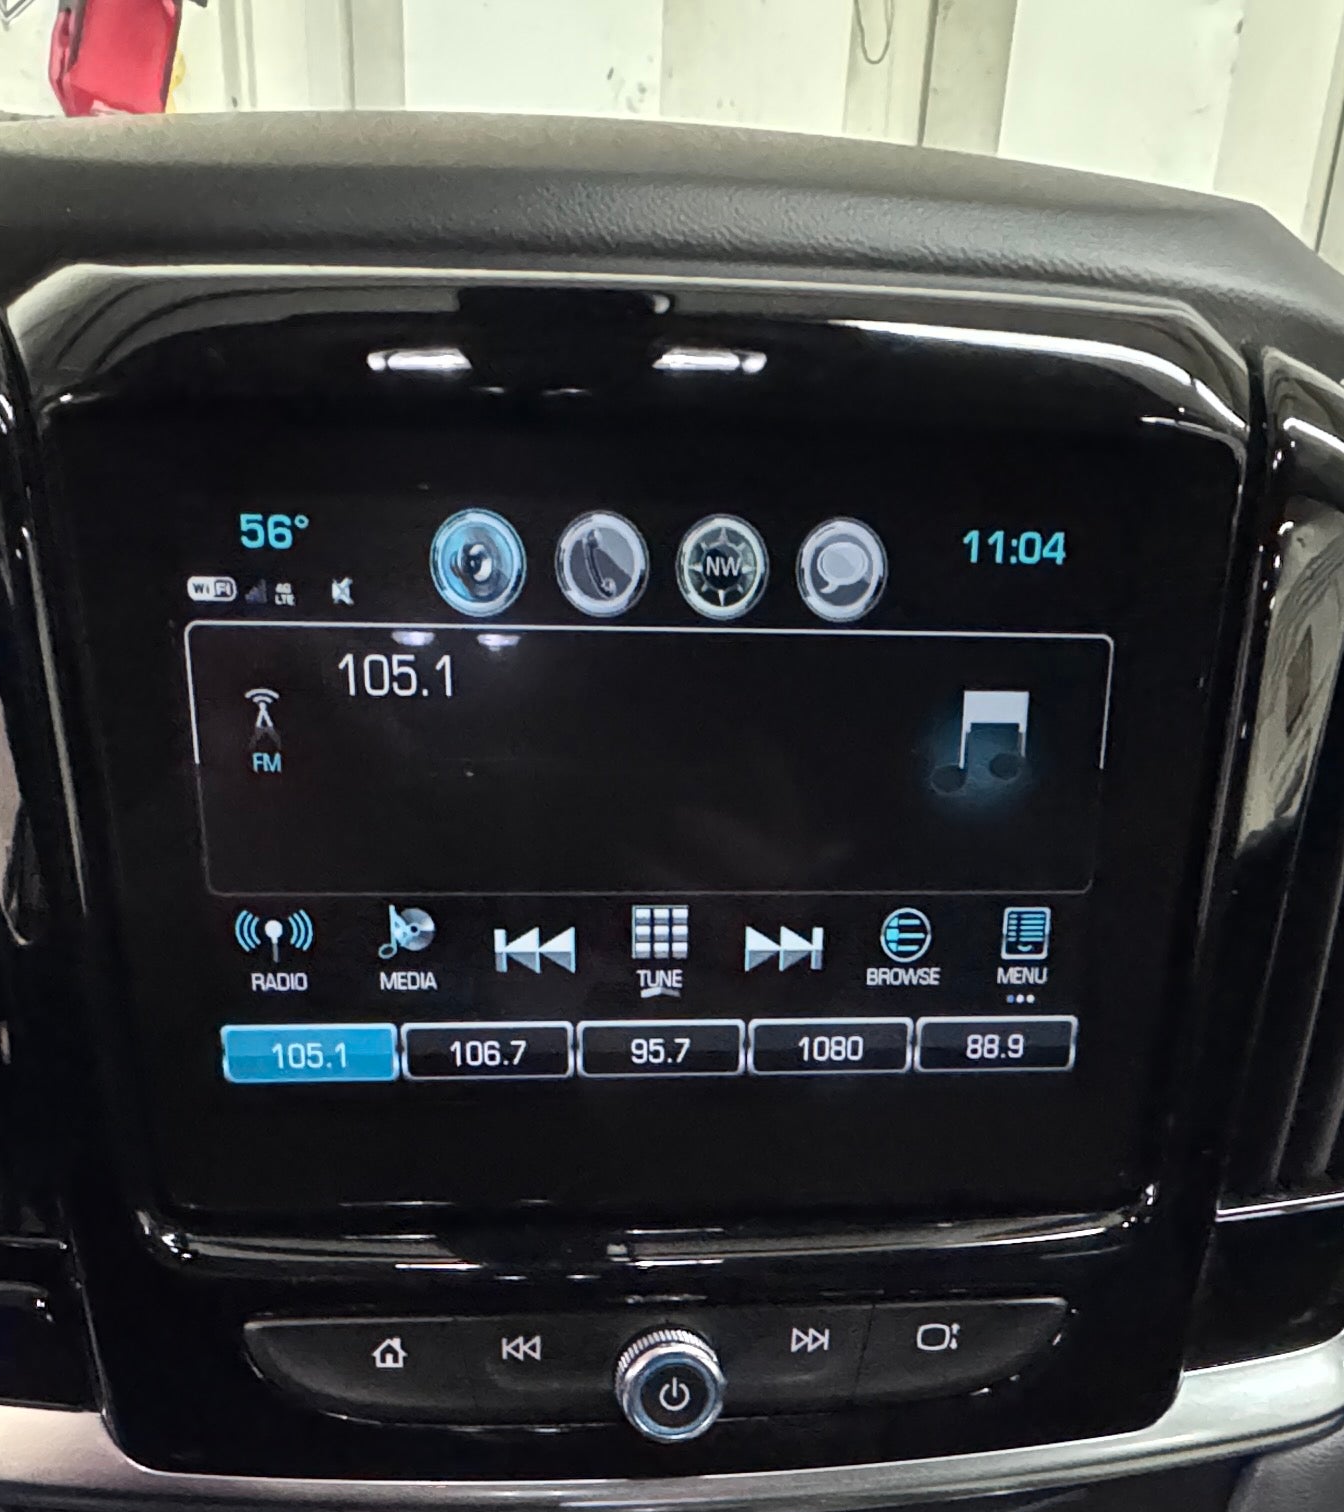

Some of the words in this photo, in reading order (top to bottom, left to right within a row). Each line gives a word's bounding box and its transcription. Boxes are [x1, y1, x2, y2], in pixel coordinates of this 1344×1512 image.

[239, 513, 309, 550] 56°
[963, 529, 1066, 566] 11:04
[706, 555, 742, 578] NW
[338, 653, 452, 697] 105.1
[252, 752, 282, 773] FM
[251, 972, 308, 992] RADIO
[379, 970, 438, 991] MEDIA
[636, 968, 683, 989] TUNE
[866, 967, 941, 986] BROWSE
[996, 966, 1048, 985] MENU
[271, 1042, 347, 1069] 105.1
[450, 1039, 527, 1067] 106.7
[630, 1037, 691, 1064] 95.7
[798, 1035, 864, 1062] 1080
[966, 1033, 1025, 1060] 88.9
